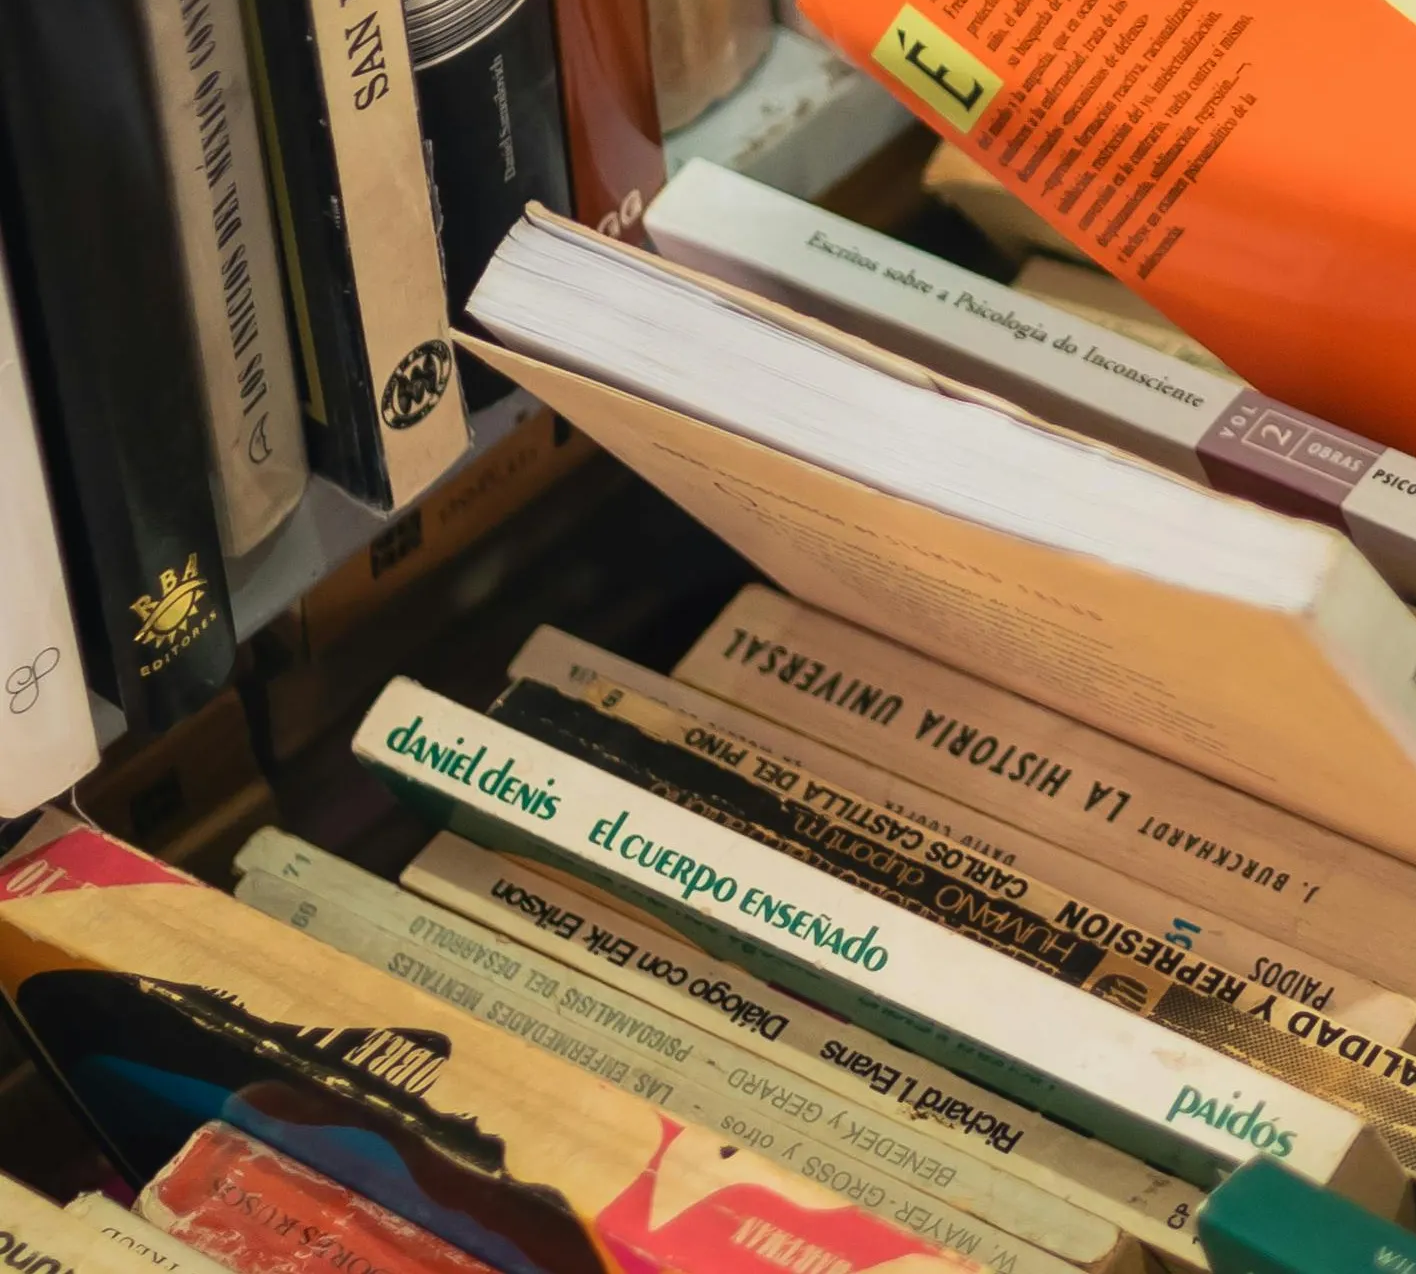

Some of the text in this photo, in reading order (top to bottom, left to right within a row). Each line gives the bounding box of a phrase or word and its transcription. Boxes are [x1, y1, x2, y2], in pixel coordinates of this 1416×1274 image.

[343, 11, 389, 112] SAN
[949, 288, 1052, 348] Psicologia
[1052, 330, 1083, 357] do
[1081, 343, 1207, 409] Inconsciente
[1218, 406, 1258, 439] VOL
[1307, 442, 1364, 472] OBRAS
[130, 552, 200, 623] RBA
[140, 610, 219, 675] EDITORES
[721, 624, 908, 730] UNIVERSAL
[909, 705, 1074, 802] HISTORIA
[678, 724, 1030, 903] CARLOS CASTILLA DEL PINO
[1079, 777, 1133, 826] LA
[1137, 812, 1292, 894] BURCKHARDT
[389, 950, 487, 1013] MENTALES
[407, 911, 524, 982] DESARROLLO
[1056, 887, 1247, 1006] REPRESION
[487, 877, 1026, 1157] Richard Evans Diálogo con Erik Erikson
[525, 968, 564, 1002] DEL
[485, 997, 636, 1086] ENFERMEDADES
[631, 1068, 677, 1105] LAS
[725, 1063, 828, 1127] GERARD
[719, 1113, 779, 1155] otros
[843, 1118, 959, 1189] BENEDEK
